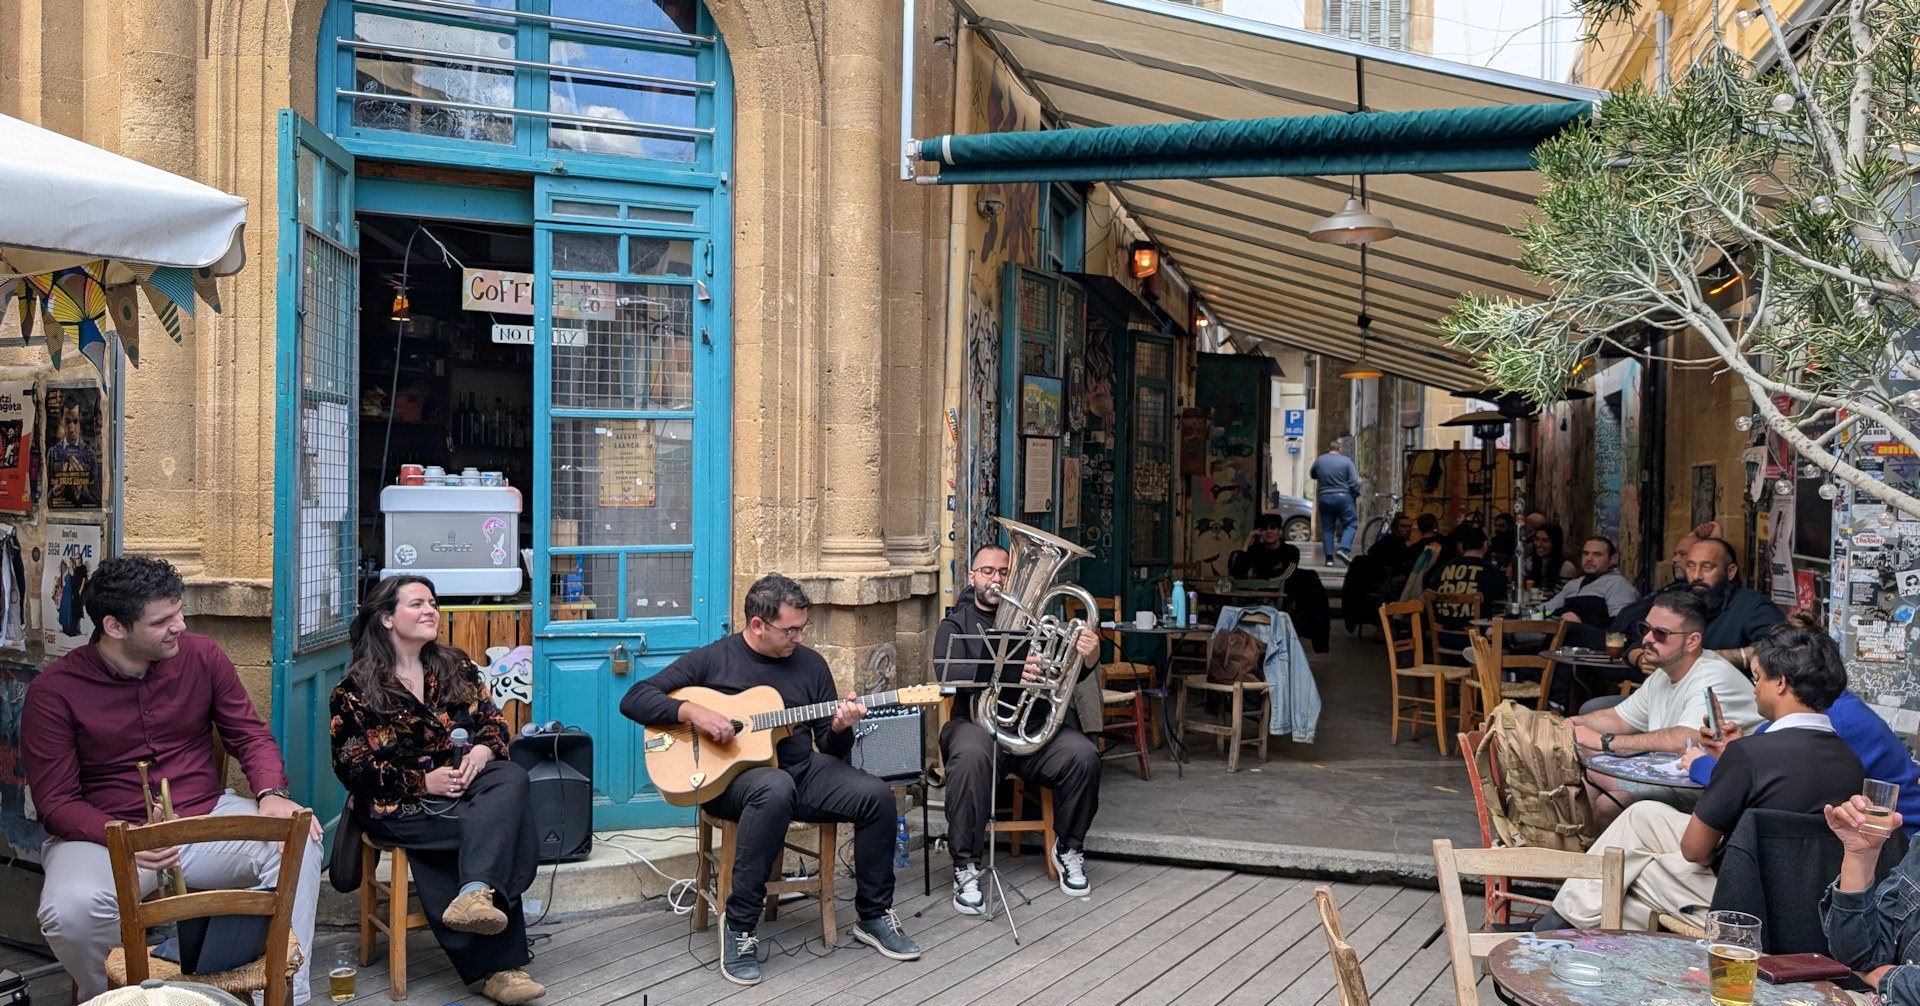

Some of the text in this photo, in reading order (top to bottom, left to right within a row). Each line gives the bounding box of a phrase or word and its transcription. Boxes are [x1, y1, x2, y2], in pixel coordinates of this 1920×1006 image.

[471, 276, 565, 306] CoFFE
[500, 328, 522, 341] NO
[1290, 411, 1300, 424] P
[1441, 564, 1483, 581] NOT
